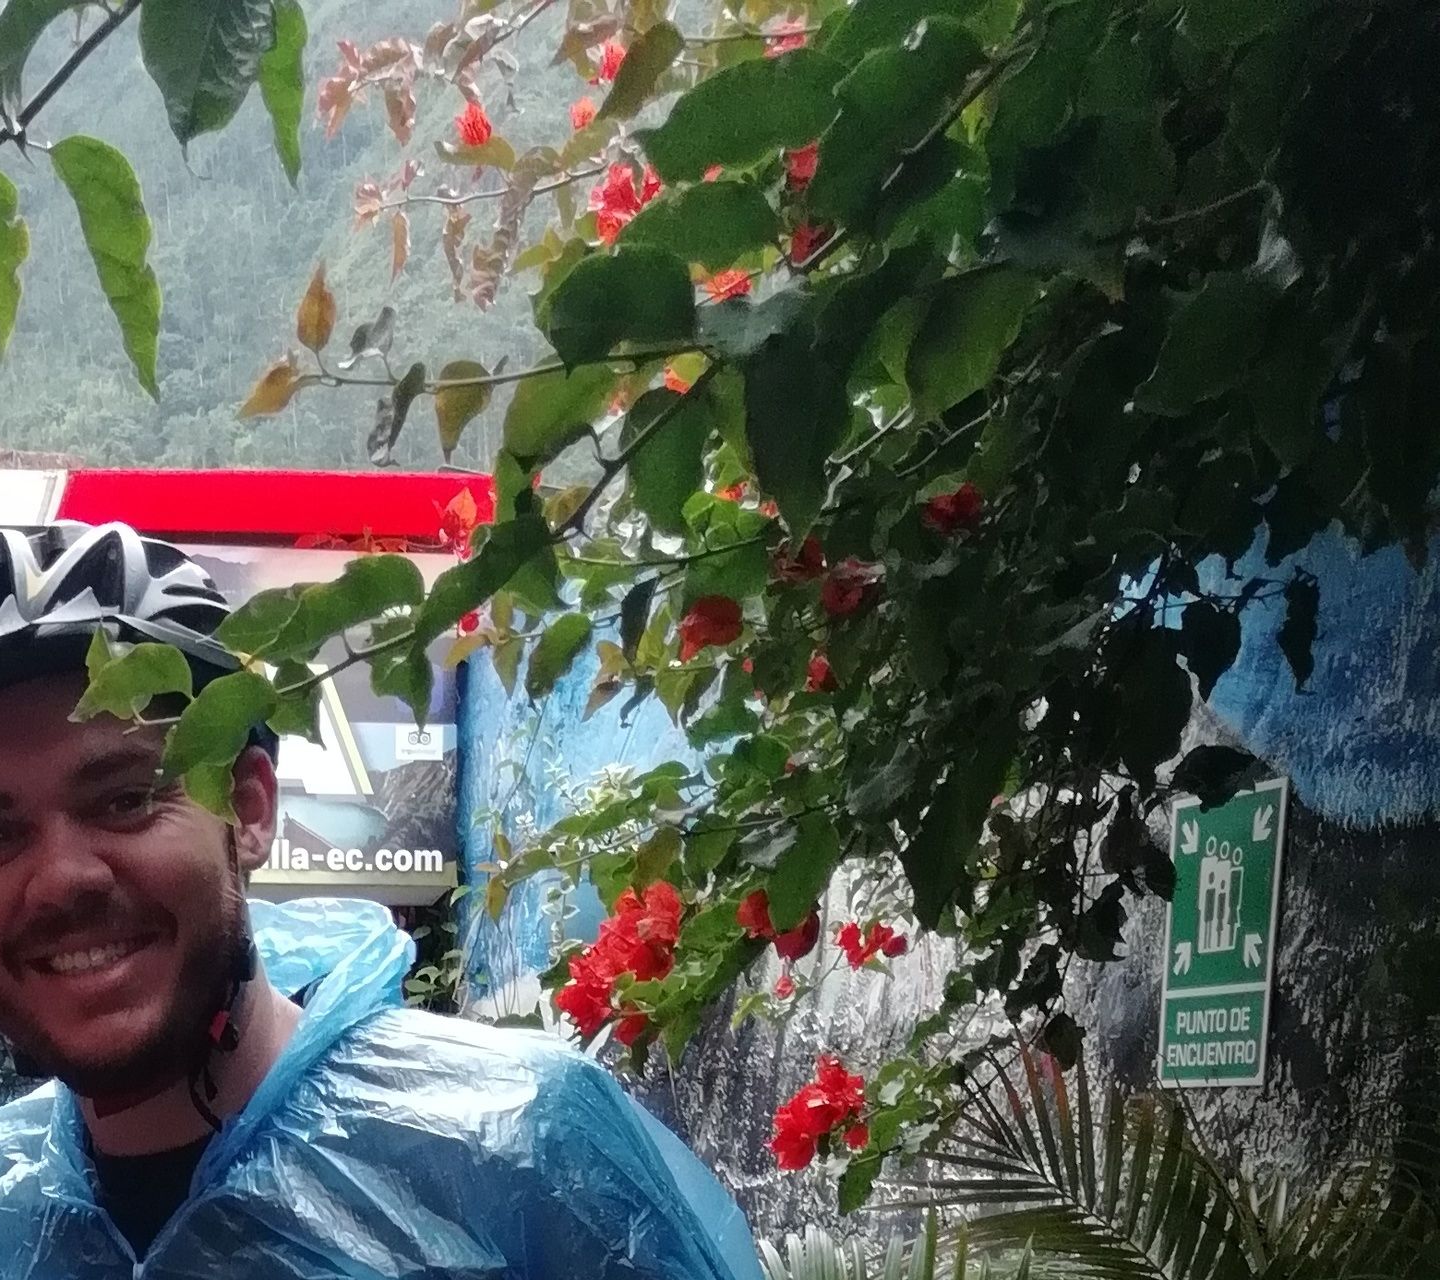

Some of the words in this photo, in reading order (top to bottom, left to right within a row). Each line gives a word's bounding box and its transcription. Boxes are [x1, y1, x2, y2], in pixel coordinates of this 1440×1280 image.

[1176, 1009, 1226, 1034] PUNTO
[1230, 1006, 1251, 1032] DE
[1166, 1040, 1256, 1067] ENCUENTRO
